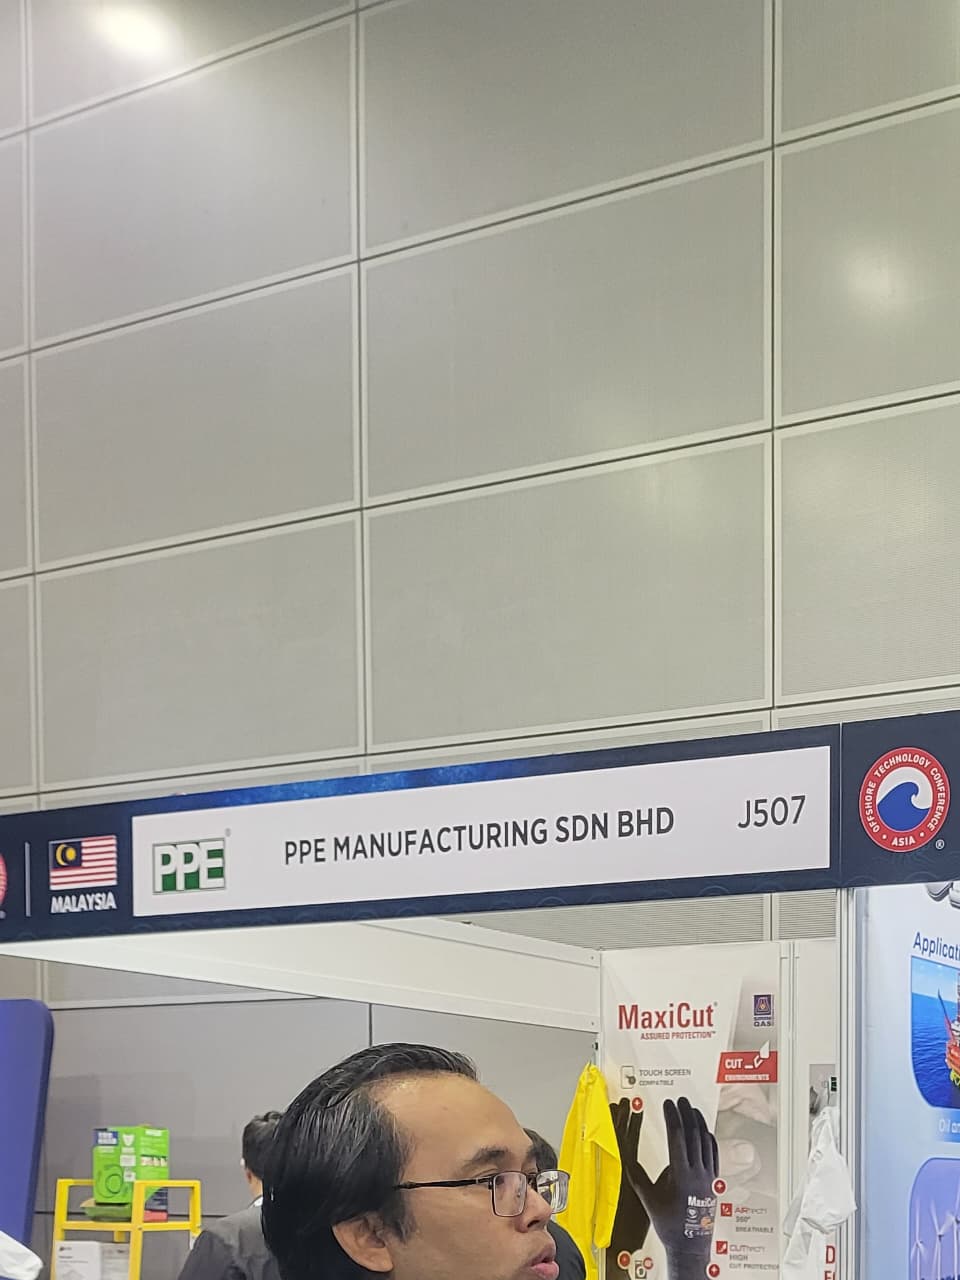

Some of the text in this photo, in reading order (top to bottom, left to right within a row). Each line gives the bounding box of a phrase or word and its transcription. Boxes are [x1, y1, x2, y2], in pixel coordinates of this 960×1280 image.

[874, 753, 931, 779] TECHNOLOGY
[737, 795, 807, 829] J507
[864, 780, 880, 833] OFFSHORE
[926, 767, 946, 832] CONFERENCE
[284, 806, 675, 866] PPE MANUFACTURING SDN BHD
[891, 835, 916, 847] ASIA
[153, 839, 225, 893] PPE
[50, 890, 118, 914] MALAYSIA
[618, 1002, 714, 1030] MaxiCut
[640, 1031, 670, 1040] ASSURED
[639, 1068, 692, 1077] TOUCH SCREEN
[725, 1058, 743, 1070] CUT
